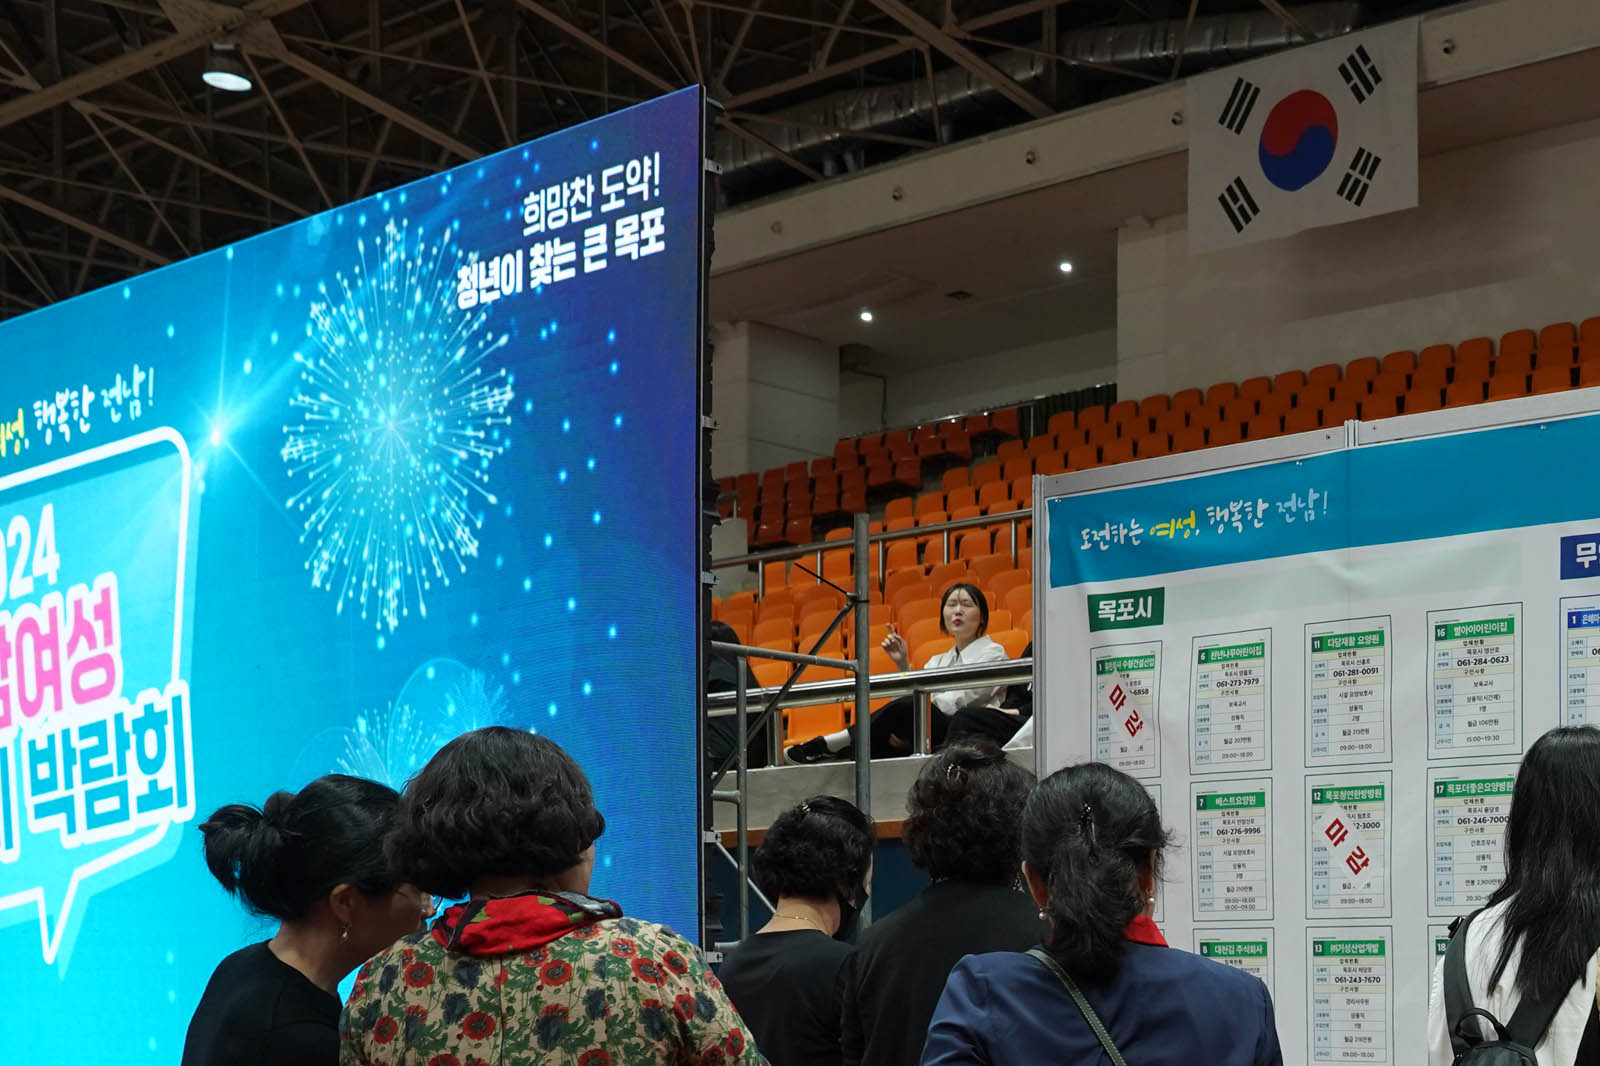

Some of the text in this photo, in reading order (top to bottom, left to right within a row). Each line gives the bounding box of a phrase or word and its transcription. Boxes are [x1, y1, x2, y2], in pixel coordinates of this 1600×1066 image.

[523, 151, 660, 237] 희망찬 도약!
[457, 206, 665, 310] 청년이 찾는 큰 목포
[33, 384, 95, 445] 행복한
[101, 363, 155, 423] 전남!
[1081, 488, 1328, 551] 도전하는 여성, 행복한 전남!
[0, 502, 61, 601] 24
[1098, 596, 1153, 622] 목포시
[1572, 616, 1576, 624] 1
[1314, 641, 1320, 649] 11
[1358, 634, 1379, 645] 요양원
[1437, 628, 1445, 637] 16
[0, 586, 116, 729] 여성
[1201, 652, 1205, 660] 6
[1457, 656, 1509, 667] 061-284-0623
[1333, 668, 1379, 677] 061-281-0091
[27, 694, 189, 835] 박람회
[1314, 792, 1320, 800] 12
[1436, 785, 1444, 793] 17
[1324, 817, 1370, 875] 마감
